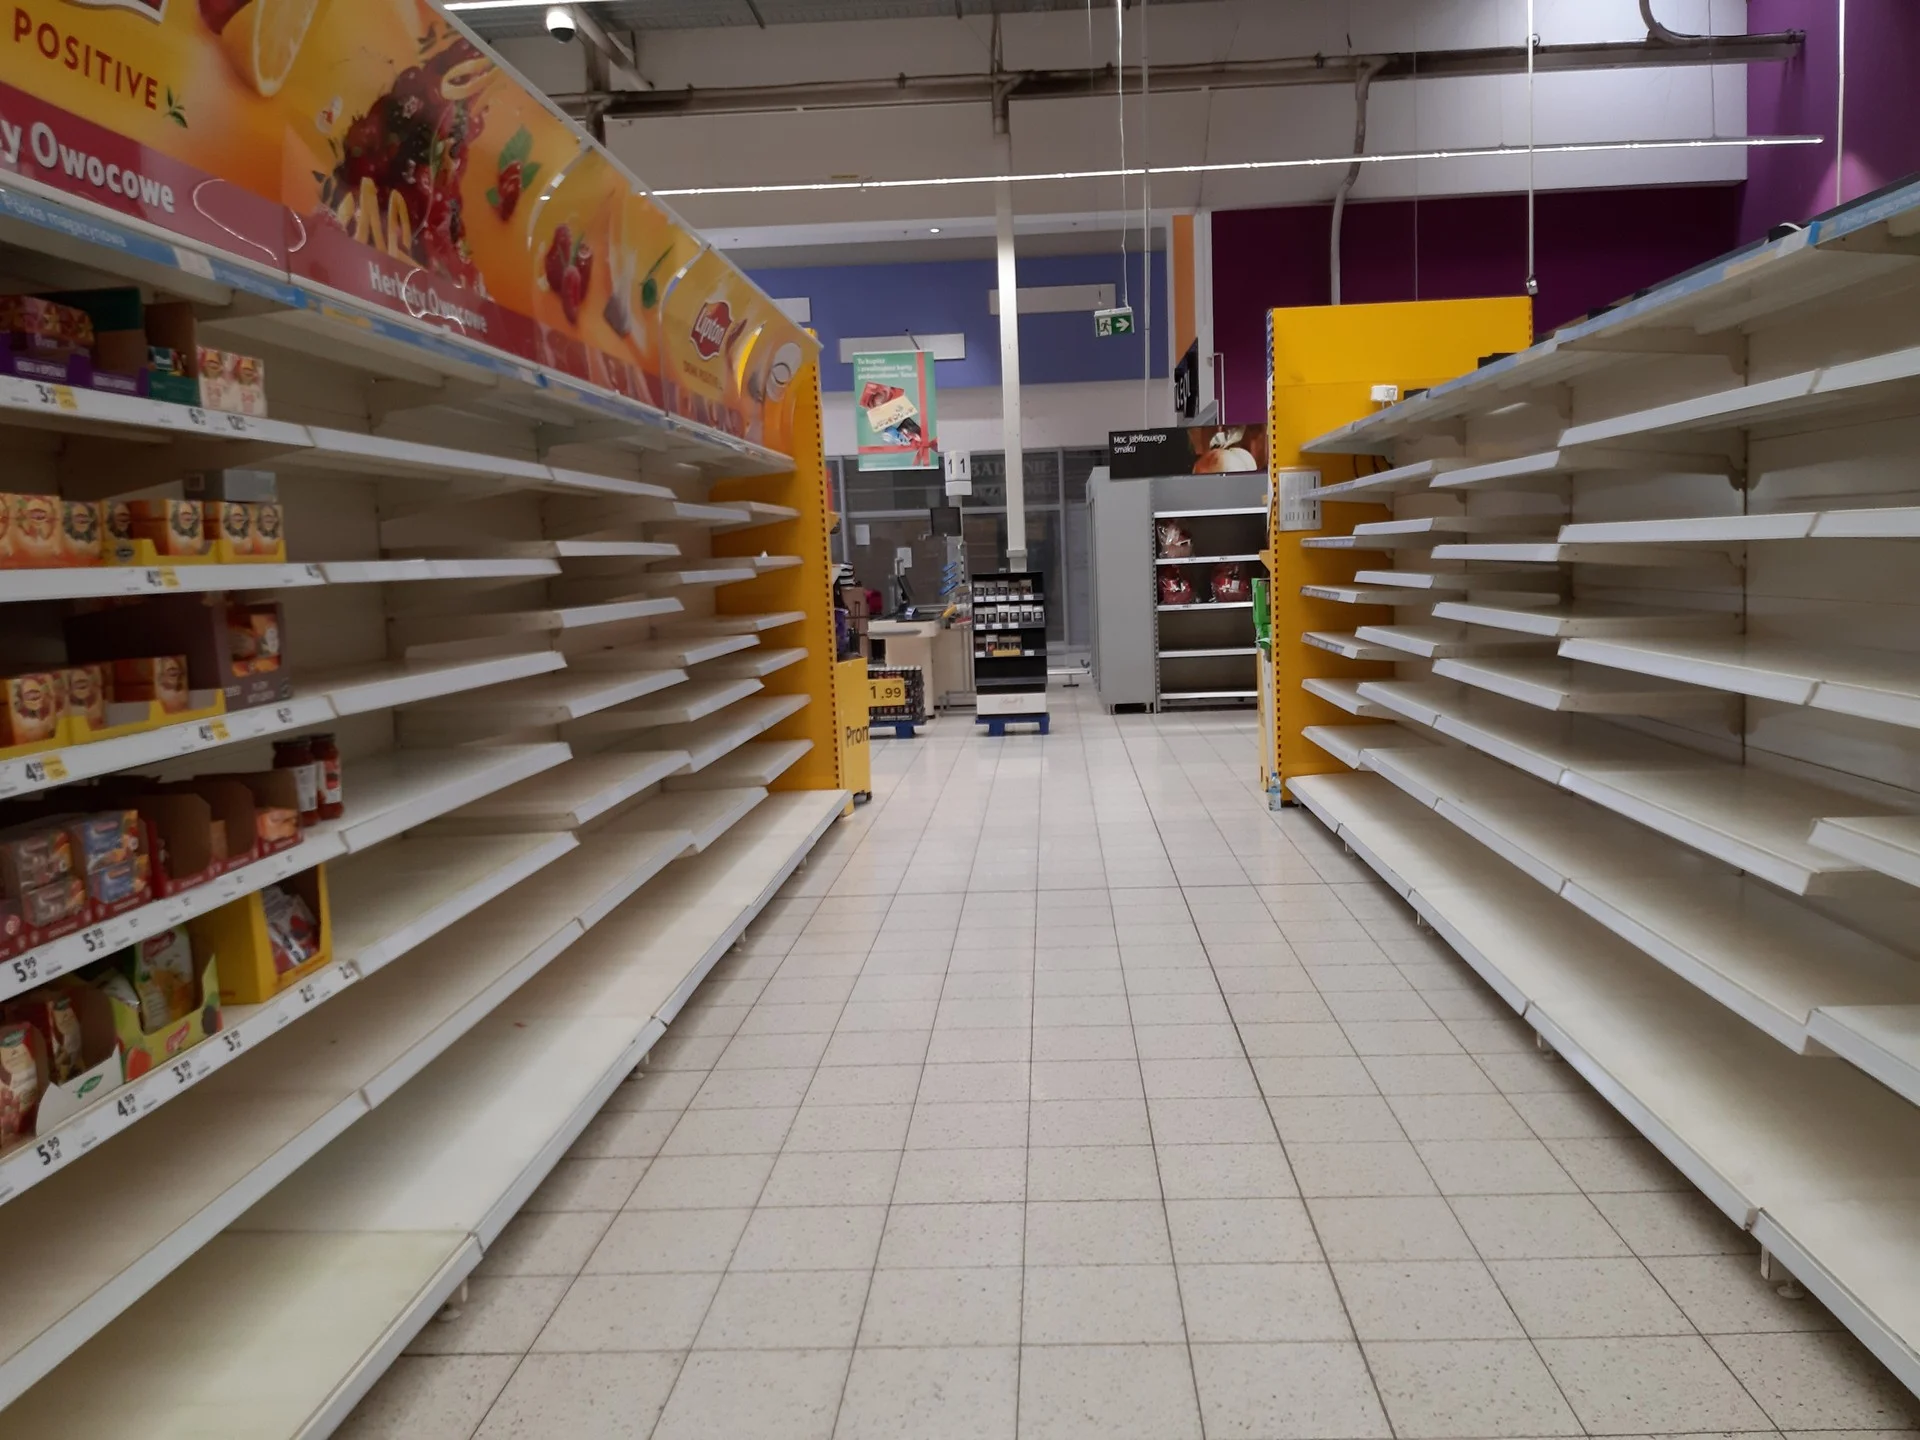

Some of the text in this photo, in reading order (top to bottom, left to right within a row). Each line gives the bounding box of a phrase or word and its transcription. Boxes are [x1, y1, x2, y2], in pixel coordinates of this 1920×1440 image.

[13, 8, 158, 111] POSITIVE
[30, 121, 176, 214] Owocowe
[695, 308, 726, 346] Lipton
[1113, 436, 1127, 445] Moc
[1114, 446, 1136, 455] smaku
